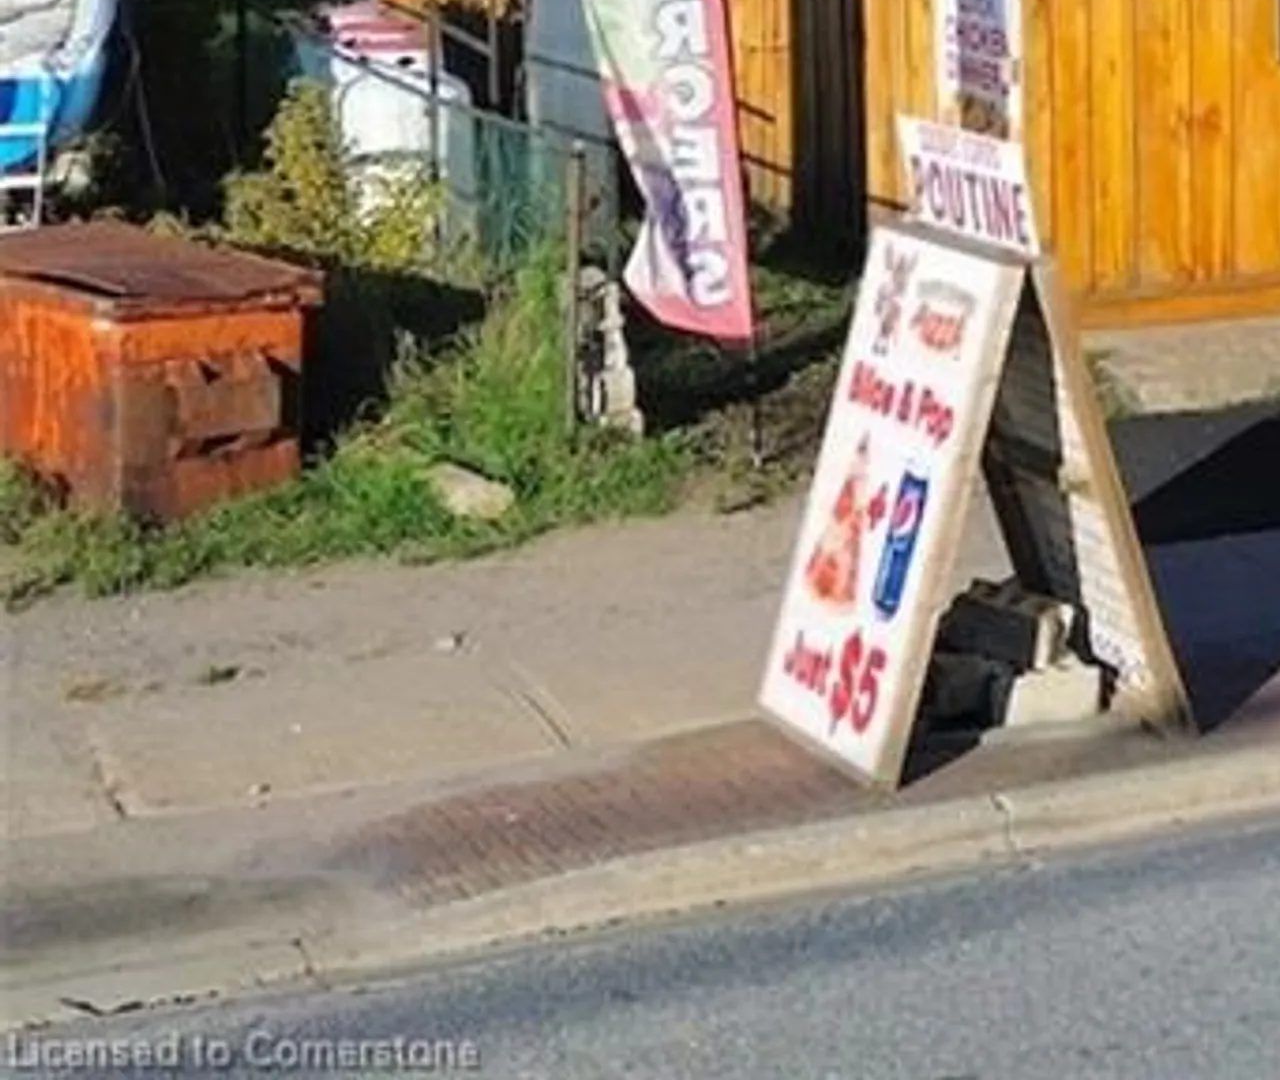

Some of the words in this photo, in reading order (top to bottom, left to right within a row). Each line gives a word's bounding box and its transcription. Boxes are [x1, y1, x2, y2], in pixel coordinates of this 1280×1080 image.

[908, 154, 1031, 246] POUTINE
[914, 385, 954, 450] Pop
[828, 626, 888, 736] $5
